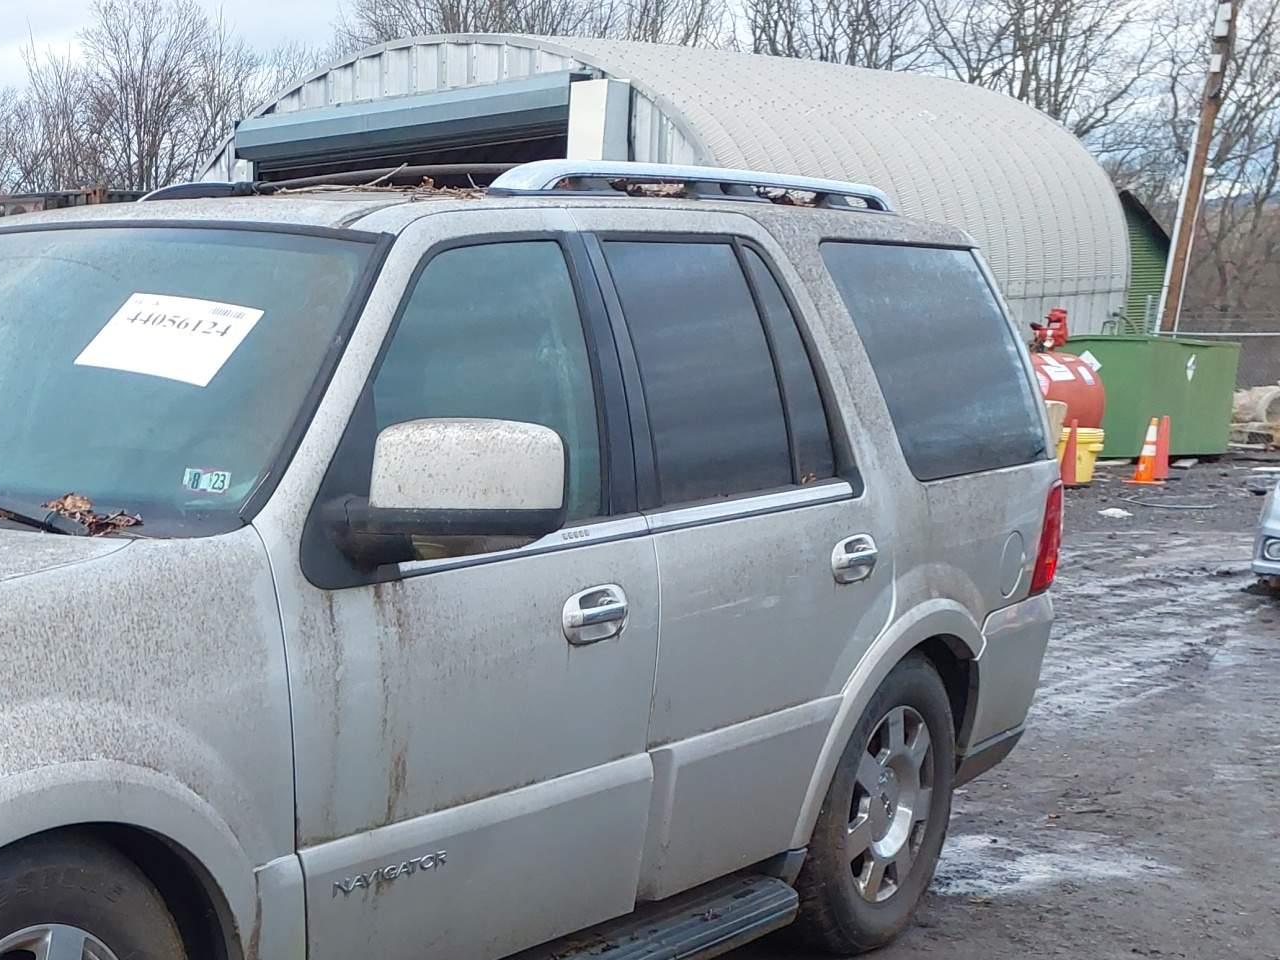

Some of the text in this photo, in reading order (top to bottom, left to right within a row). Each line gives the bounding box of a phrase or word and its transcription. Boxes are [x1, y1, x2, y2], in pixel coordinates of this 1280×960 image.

[127, 311, 232, 337] 44056124
[191, 472, 201, 489] 8
[212, 472, 226, 490] 23
[332, 849, 447, 898] NAVIGATOR
